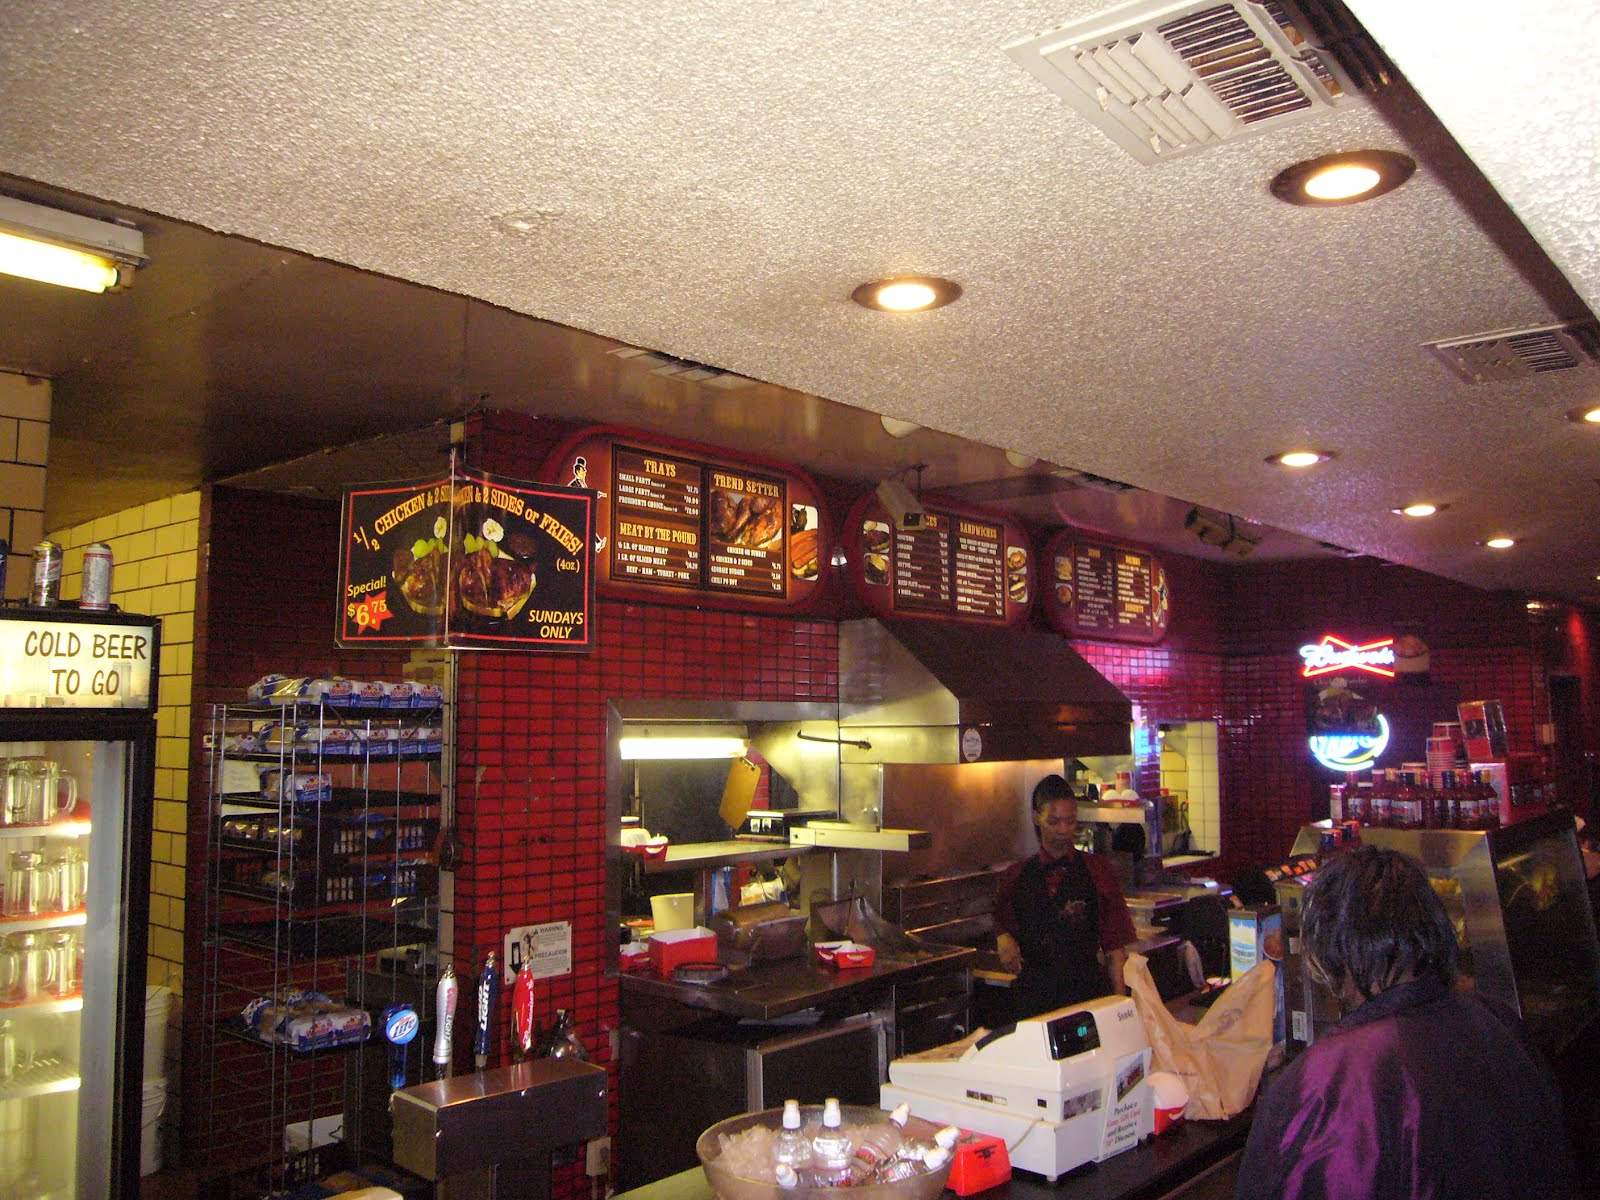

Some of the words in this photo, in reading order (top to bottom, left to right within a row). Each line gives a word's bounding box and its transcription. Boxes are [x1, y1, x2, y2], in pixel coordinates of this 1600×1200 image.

[644, 460, 676, 477] TRAYS
[714, 474, 744, 490] TREND
[746, 480, 779, 498] SETTER
[374, 493, 425, 535] CHICKEN
[427, 492, 433, 507] &
[434, 487, 440, 504] 2
[475, 486, 481, 503] &
[483, 486, 489, 504] 2
[490, 488, 524, 516] SIDES
[525, 509, 540, 524] or
[539, 513, 584, 556] FRIES!
[620, 522, 643, 537] MEAT
[644, 526, 654, 539] BY
[655, 528, 671, 542] THE
[672, 530, 696, 545] POUND
[960, 522, 997, 539] SANDWICHES
[348, 576, 386, 598] Special!
[529, 610, 584, 625] SUNDAYS
[540, 626, 573, 639] ONLY
[25, 630, 81, 657] COLD
[93, 634, 147, 660] BEER
[52, 669, 80, 695] TO
[92, 670, 120, 695] GO
[540, 925, 564, 934] WARNING
[481, 980, 490, 1031] LIGHT
[444, 1015, 453, 1041] LIGHT
